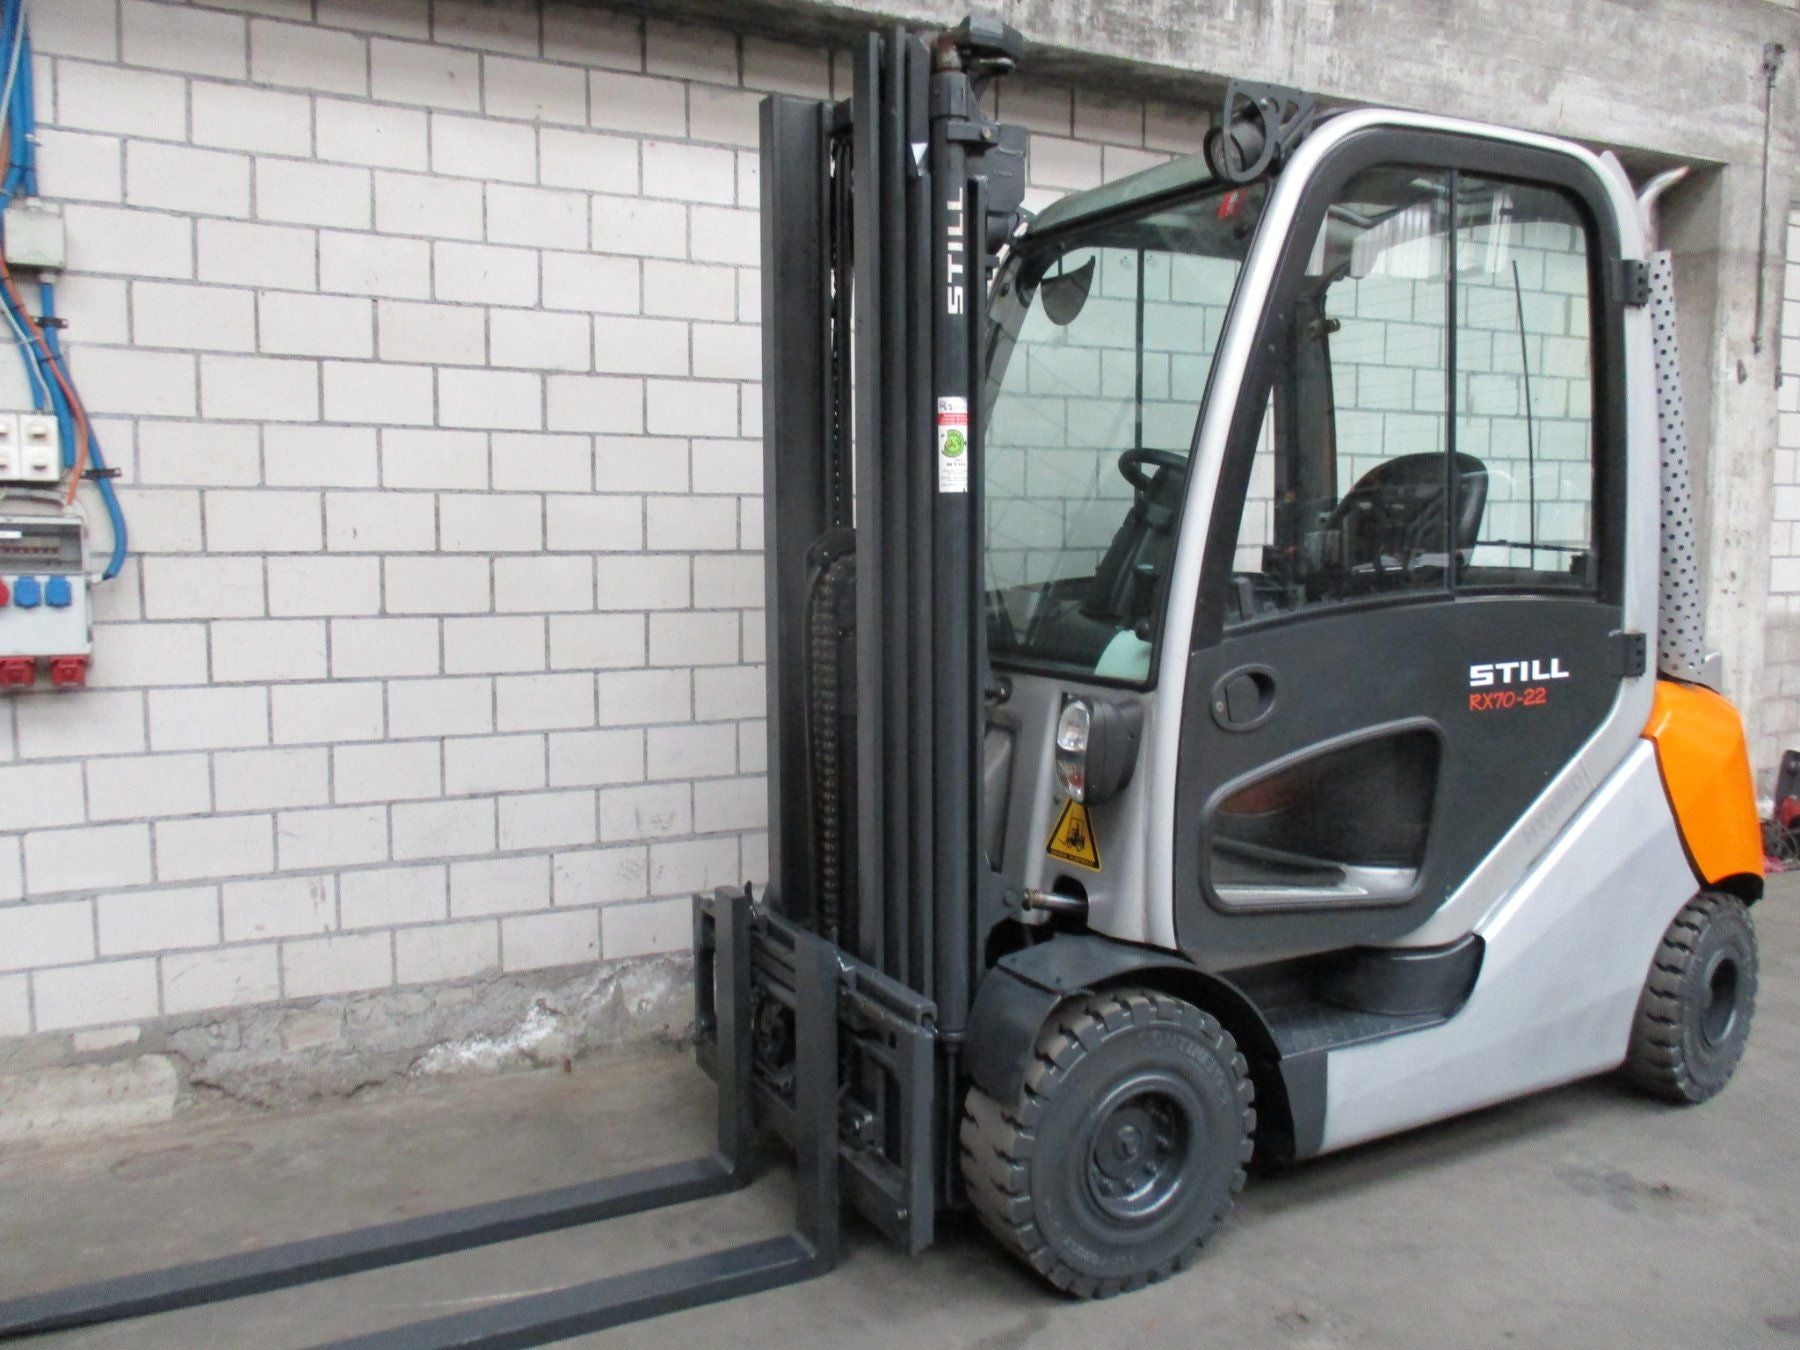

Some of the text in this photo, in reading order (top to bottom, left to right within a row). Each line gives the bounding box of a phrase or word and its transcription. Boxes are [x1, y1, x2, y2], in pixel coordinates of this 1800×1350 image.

[946, 187, 964, 315] STILL
[1469, 658, 1569, 687] STILL
[1469, 687, 1548, 711] RX70-22
